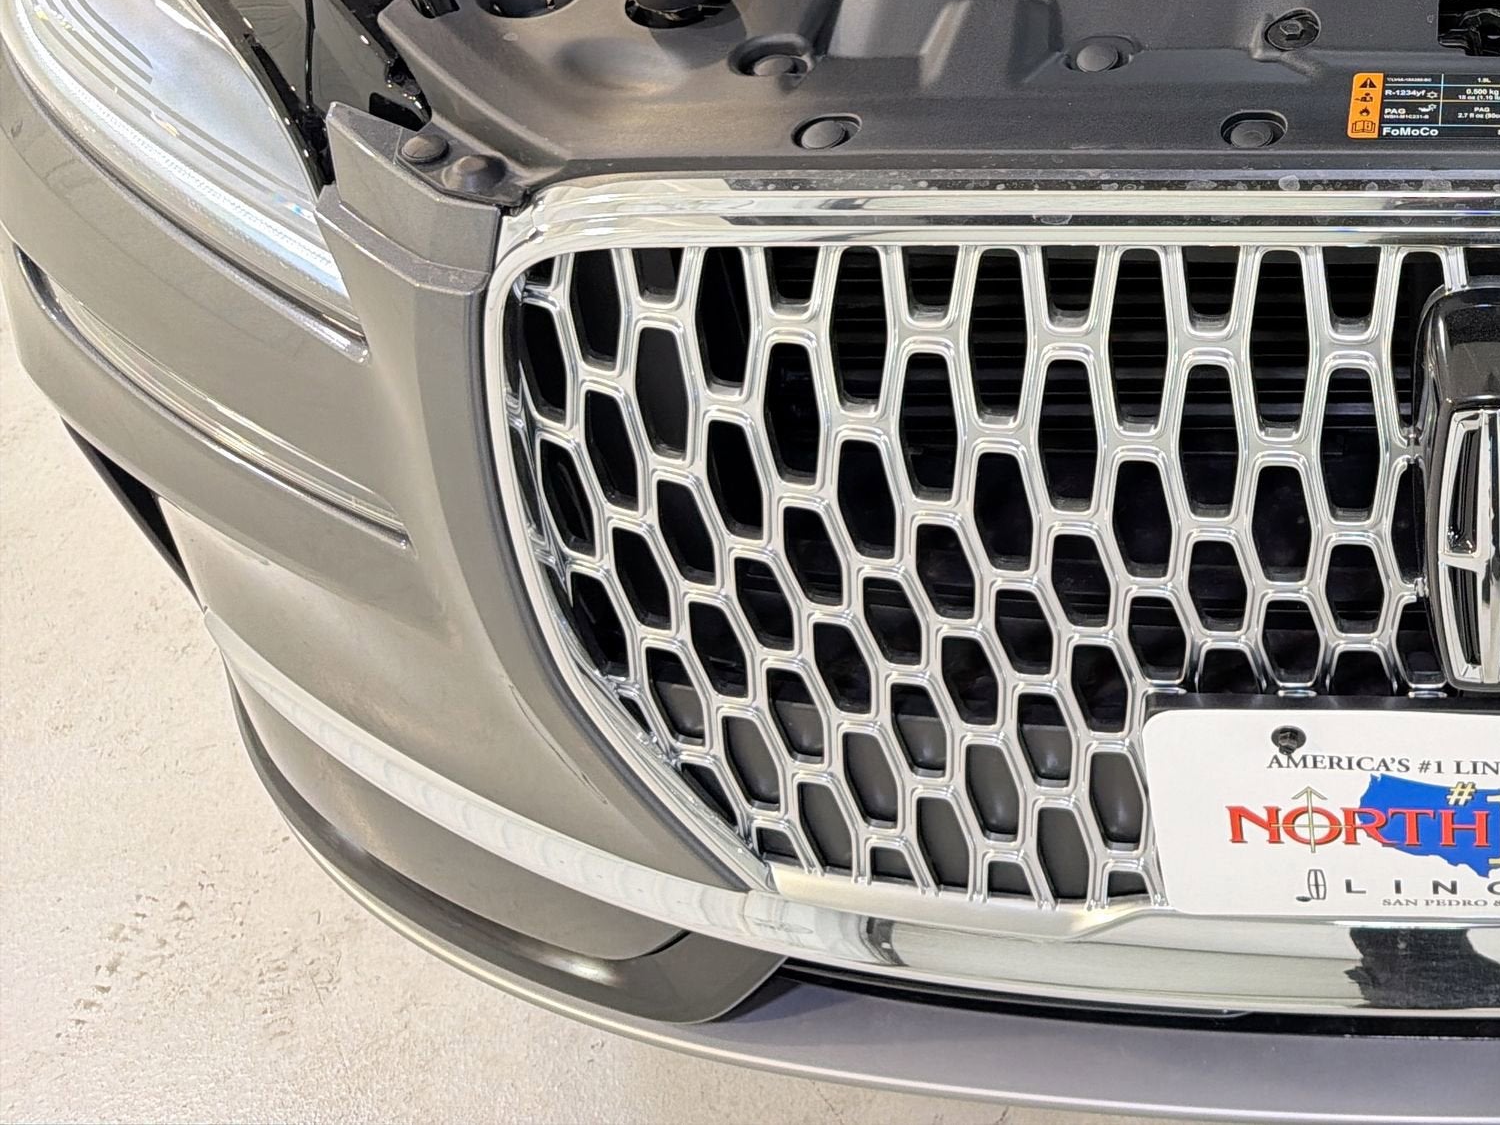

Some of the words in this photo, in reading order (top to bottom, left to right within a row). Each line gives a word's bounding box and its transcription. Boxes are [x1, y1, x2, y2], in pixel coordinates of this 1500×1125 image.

[1384, 89, 1427, 97] R-1234yf
[1382, 127, 1439, 136] FoMoCo
[1266, 753, 1410, 773] AMERICA'S
[1418, 760, 1444, 774] #1
[1225, 805, 1490, 849] NORTH
[1382, 898, 1418, 907] SAN
[1424, 898, 1488, 907] PEDRO
